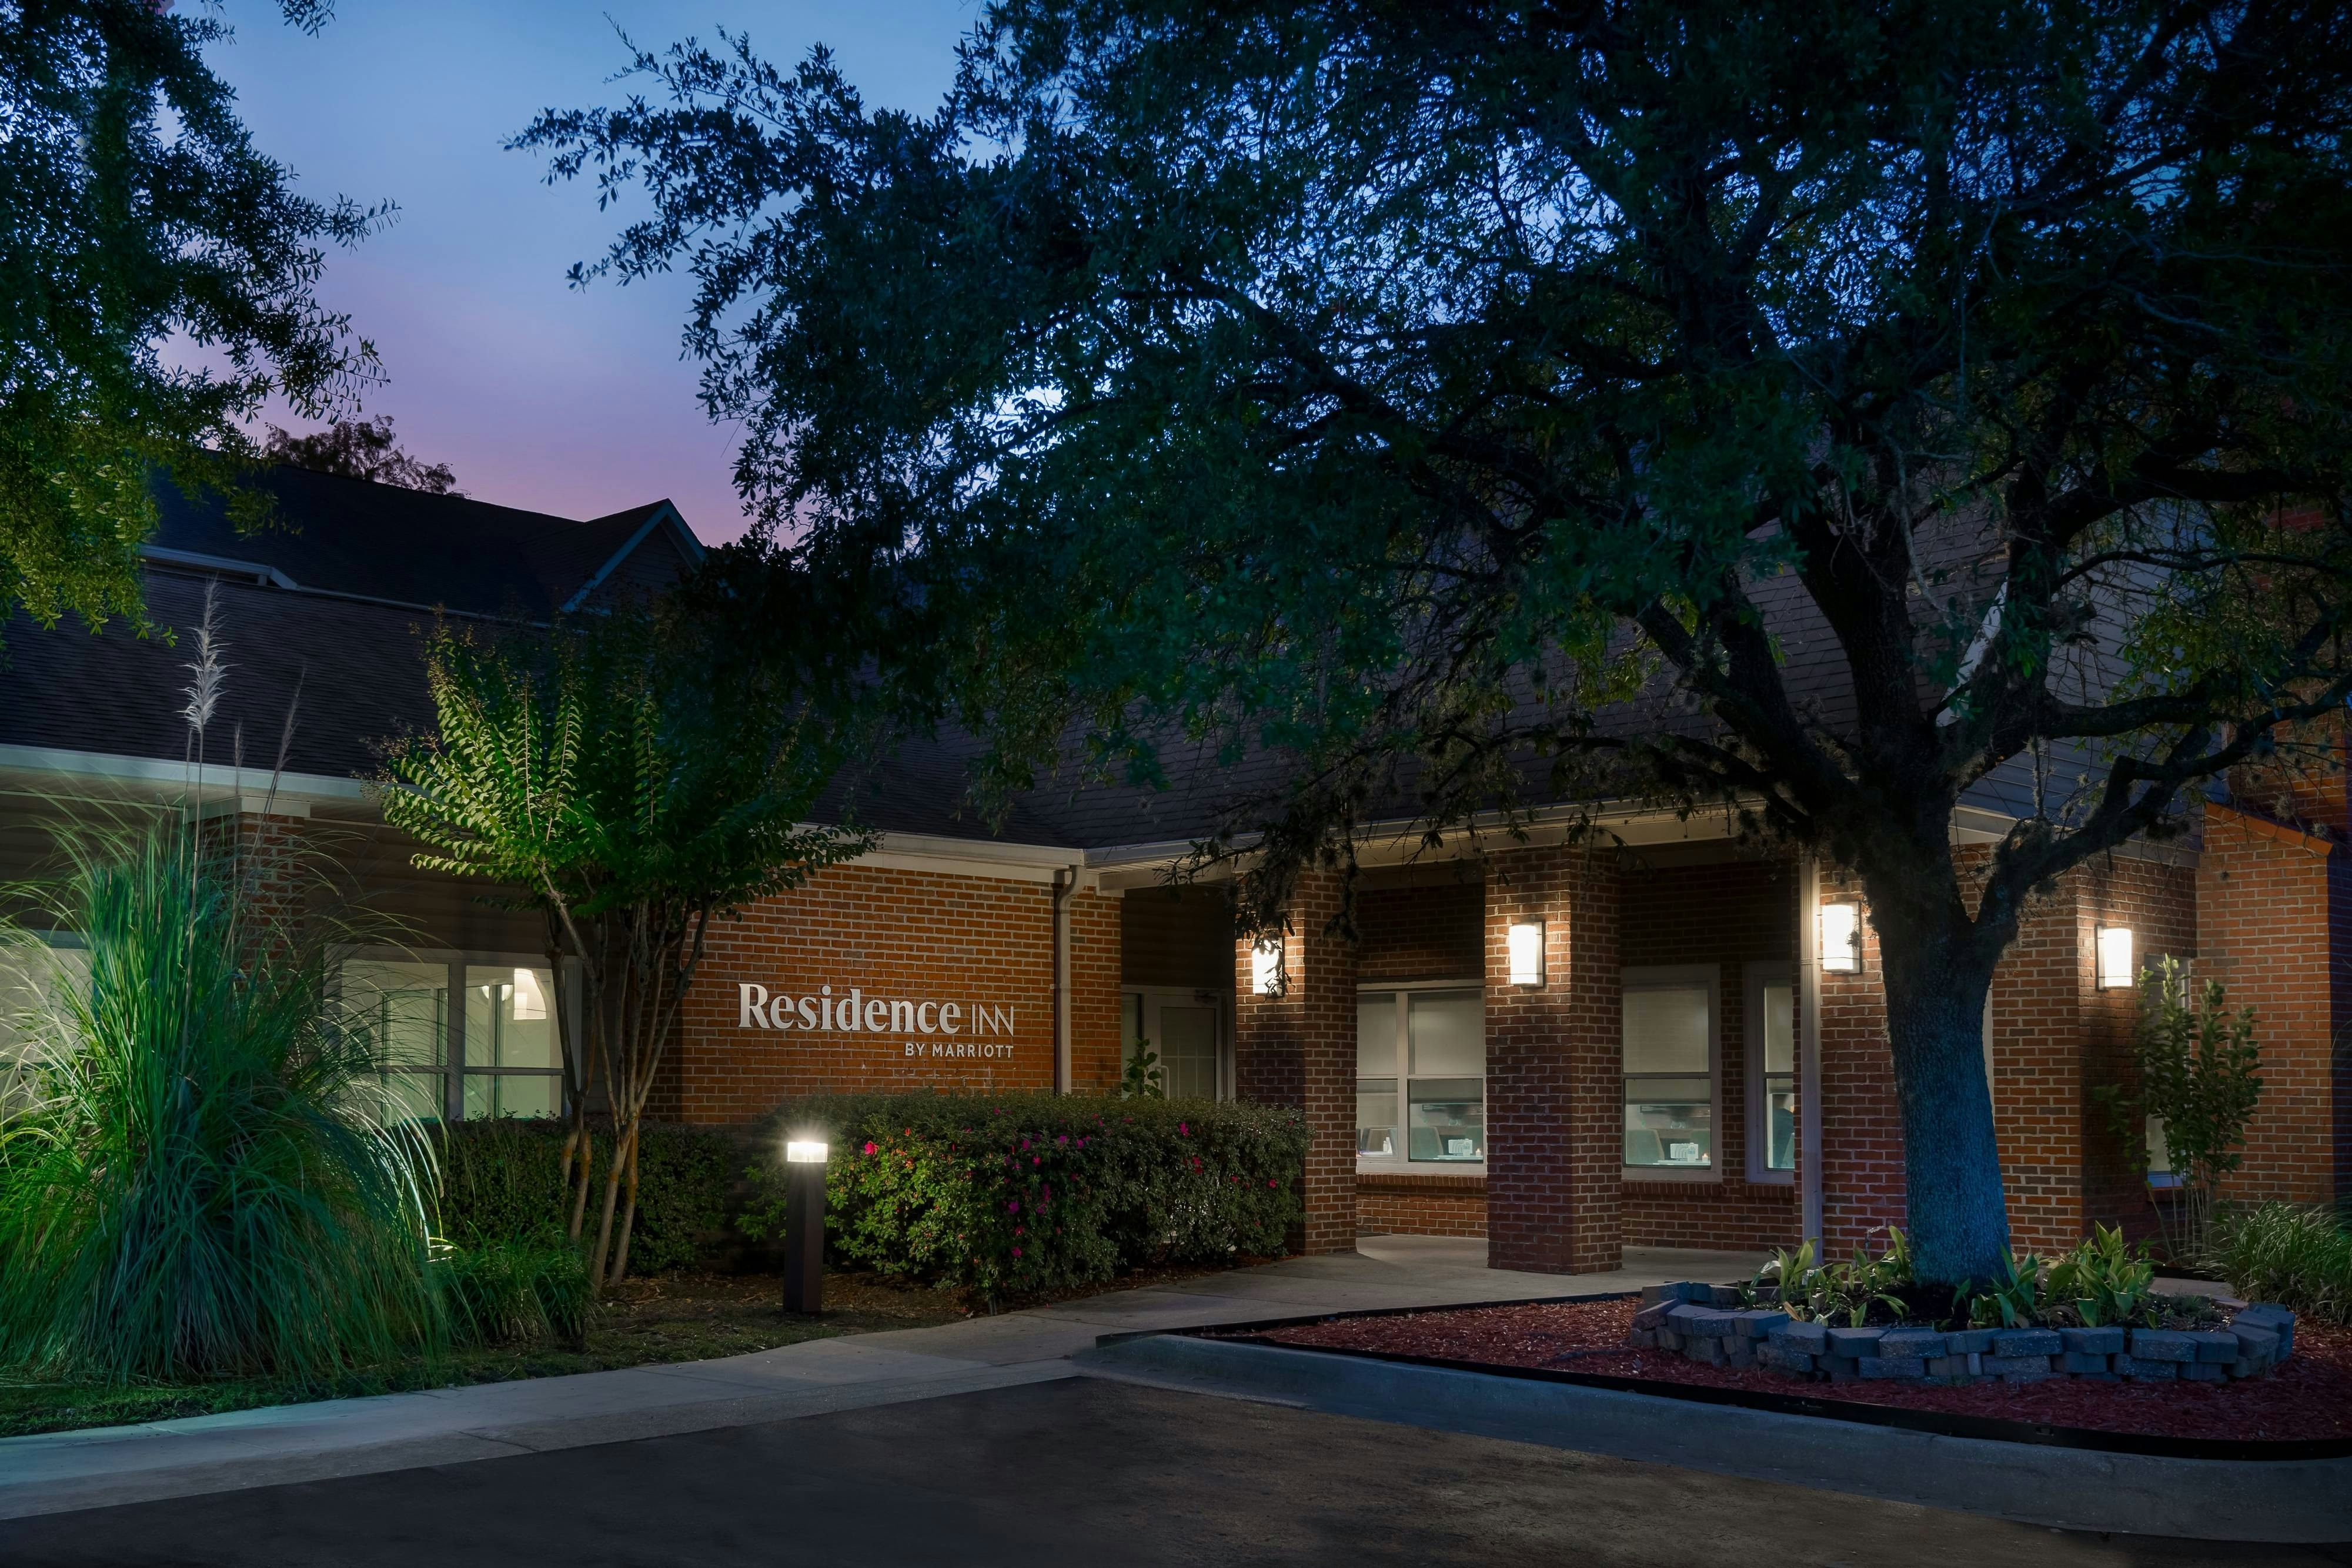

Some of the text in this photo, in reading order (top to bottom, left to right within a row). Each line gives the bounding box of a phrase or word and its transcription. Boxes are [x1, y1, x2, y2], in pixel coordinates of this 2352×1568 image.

[739, 983, 1014, 1036] Residence INN
[905, 1043, 1014, 1058] BY MARRIOTT
